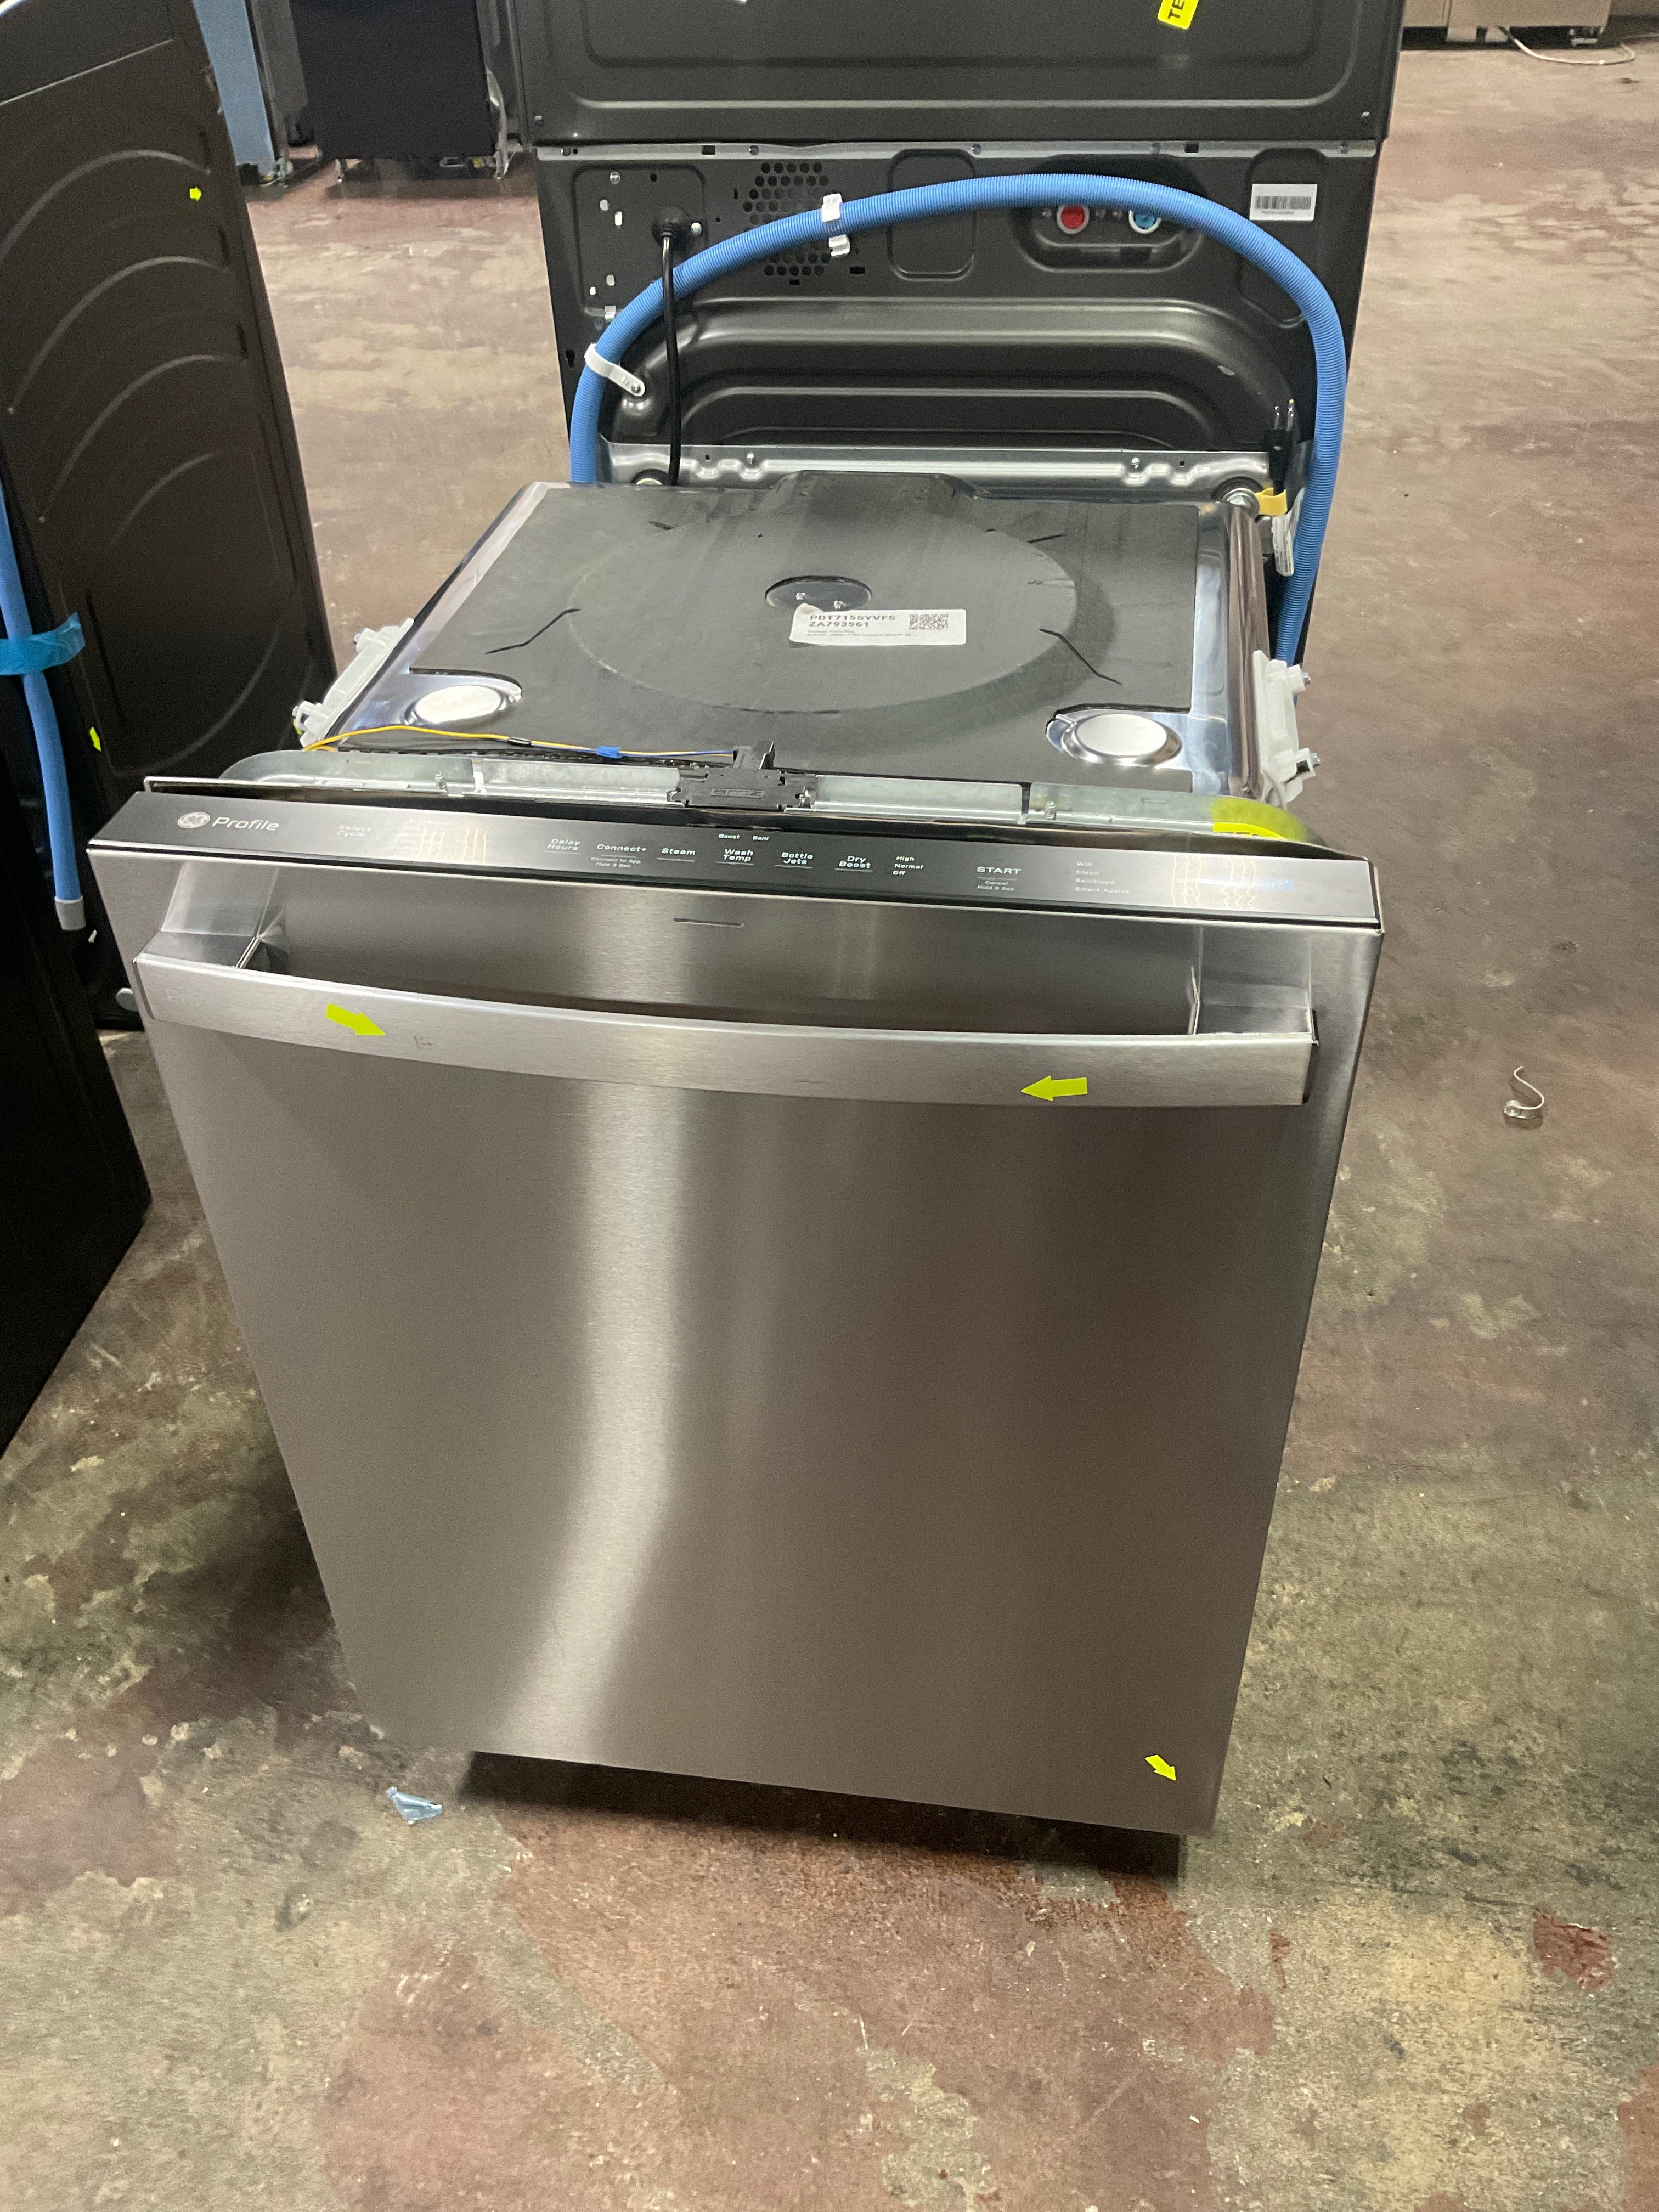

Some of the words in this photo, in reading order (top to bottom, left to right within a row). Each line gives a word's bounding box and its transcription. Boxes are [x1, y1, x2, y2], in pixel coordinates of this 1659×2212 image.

[212, 817, 279, 831] Profile
[596, 844, 647, 852] Connect+
[661, 848, 696, 856] Steam
[725, 848, 753, 856] Wash
[723, 854, 752, 862] Temp
[781, 851, 814, 860] Bottle
[977, 866, 1022, 874] START
